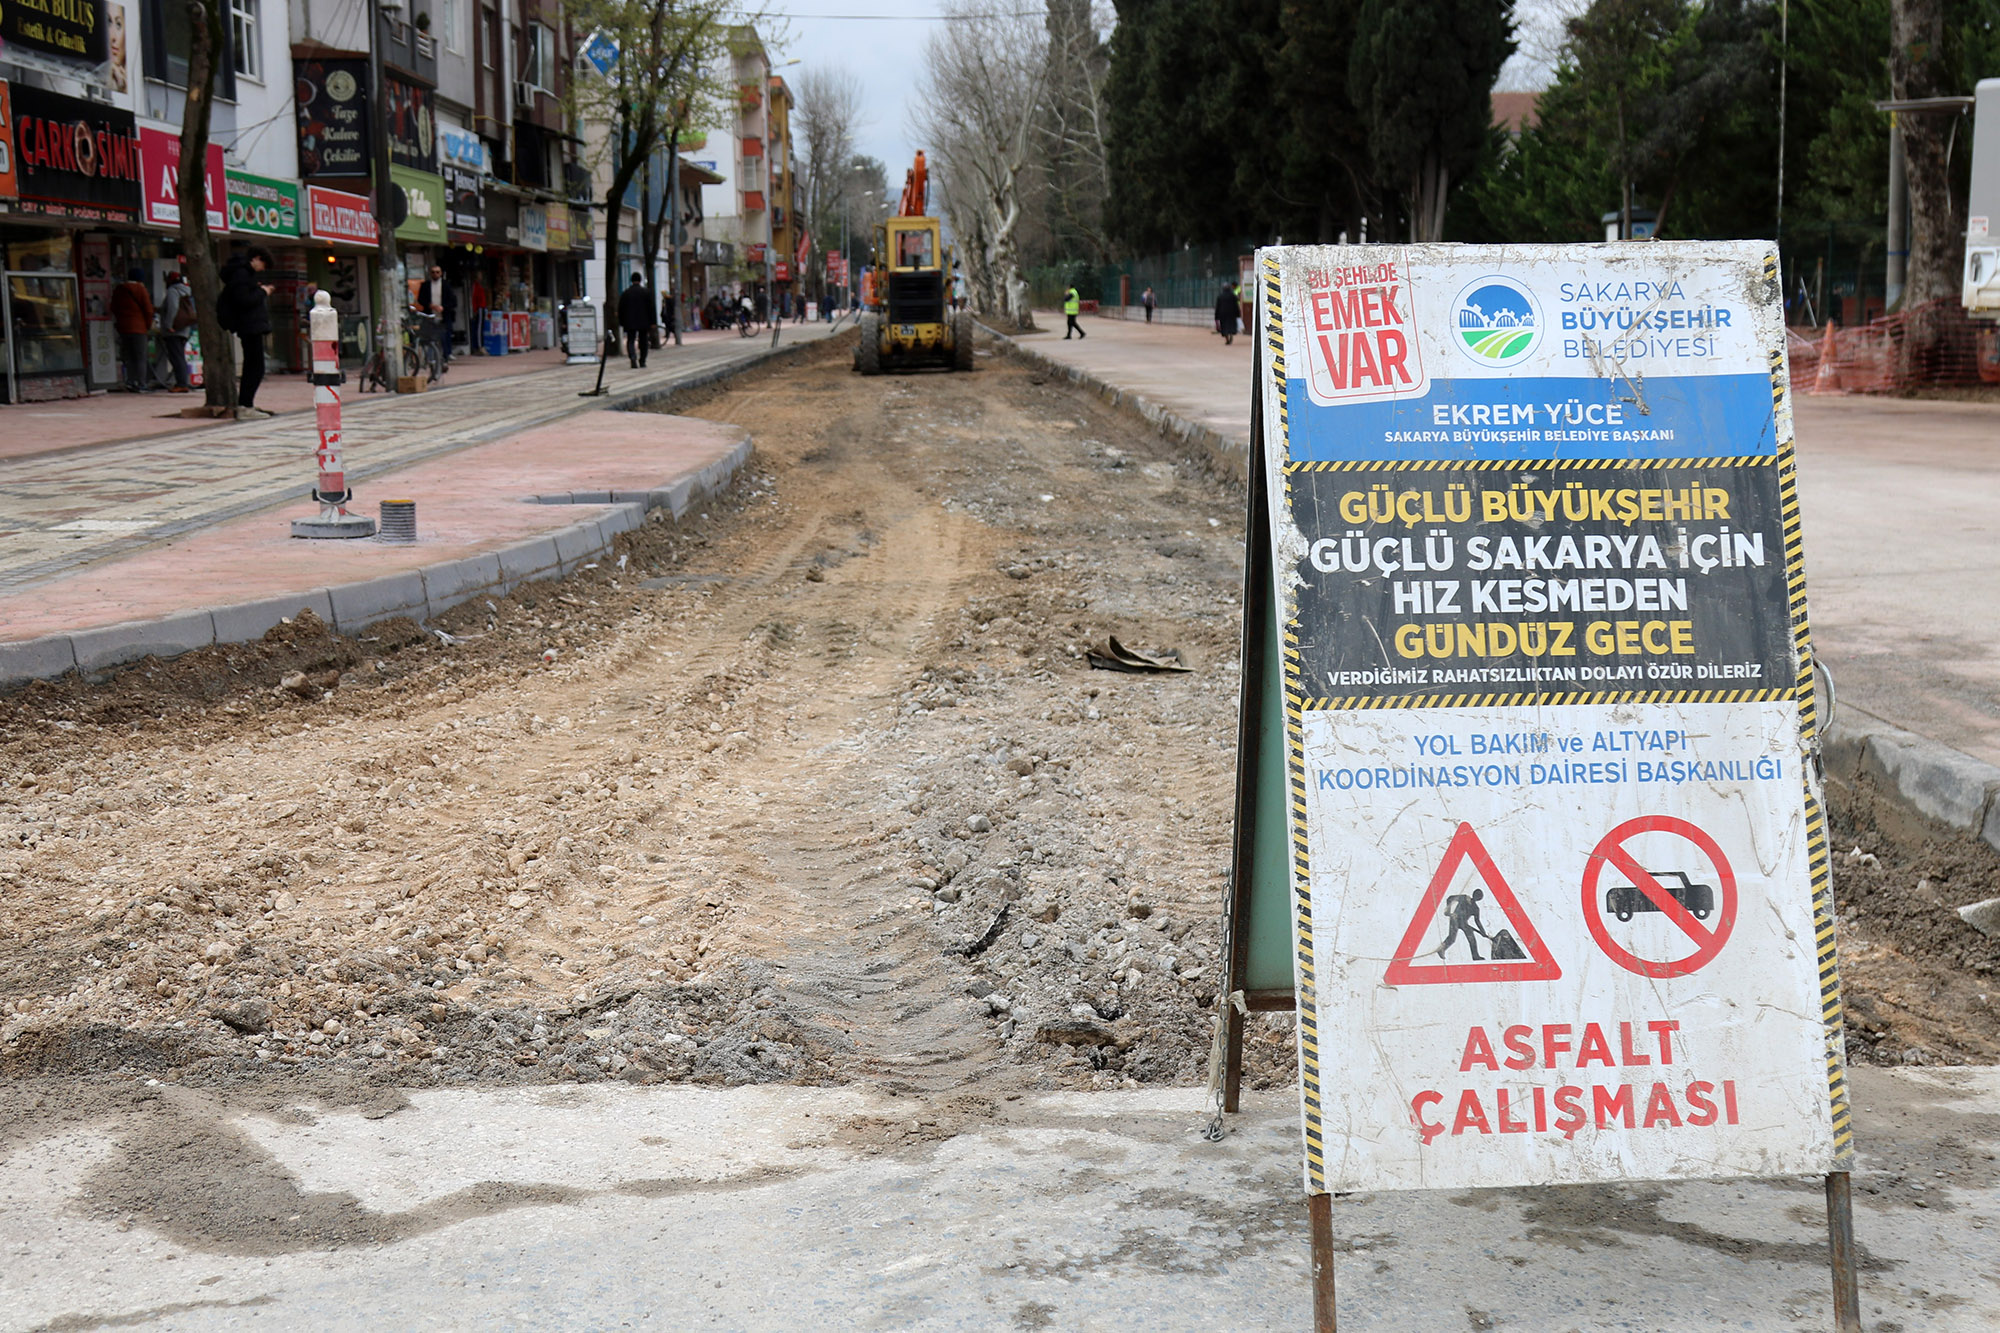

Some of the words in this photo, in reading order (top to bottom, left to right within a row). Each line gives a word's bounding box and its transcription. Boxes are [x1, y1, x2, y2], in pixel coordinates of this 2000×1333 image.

[161, 164, 213, 206] AN
[1309, 268, 1330, 288] BU
[1335, 261, 1398, 285] ŞEHİRDE
[1560, 282, 1684, 302] SAKARYA
[1311, 287, 1404, 331] EMEK
[1562, 307, 1732, 331] BÜYÜKŞEHİR
[1317, 328, 1413, 390] VAR
[1564, 335, 1715, 358] BELEDİYESİ
[1434, 403, 1535, 426] EKREM
[1545, 398, 1624, 425] YÜCE
[1385, 431, 1449, 443] SAKARYA
[1454, 427, 1541, 444] BÜYÜKŞEHİR
[1545, 426, 1609, 441] BELEDİYE
[1613, 429, 1674, 443] BAŞKANI
[1340, 484, 1472, 529] GÜÇLÜ
[1483, 481, 1731, 526] BÜYÜKŞEHİR
[1310, 529, 1453, 579] GÜÇLÜ
[1467, 534, 1667, 571] SAKARYA
[1678, 526, 1764, 575] İÇİN
[1395, 581, 1461, 614] HIZ
[1473, 578, 1687, 613] KESMEDEN
[1395, 621, 1576, 659] GÜNDÜZ
[1586, 621, 1695, 655] GECE
[1328, 666, 1428, 686] VERDİĞİMİZ
[1433, 666, 1577, 683] RAHATSIZLIKTAN
[1581, 666, 1643, 681] DOLAYI
[1647, 661, 1695, 680] ÖZÜR
[1698, 661, 1762, 679] DİLERİZ
[1414, 735, 1462, 756] YOL
[1470, 732, 1548, 755] BAKIM
[1558, 738, 1584, 753] ve
[1592, 730, 1686, 752] ALTYAPI
[1320, 762, 1520, 790] KOORDİNASYON
[1531, 759, 1628, 786] DAİRESİ
[1637, 755, 1782, 786] BAŞKANLIĞI
[1460, 1020, 1680, 1072] ASFALT
[1410, 1080, 1740, 1146] ÇALIŞMASI
